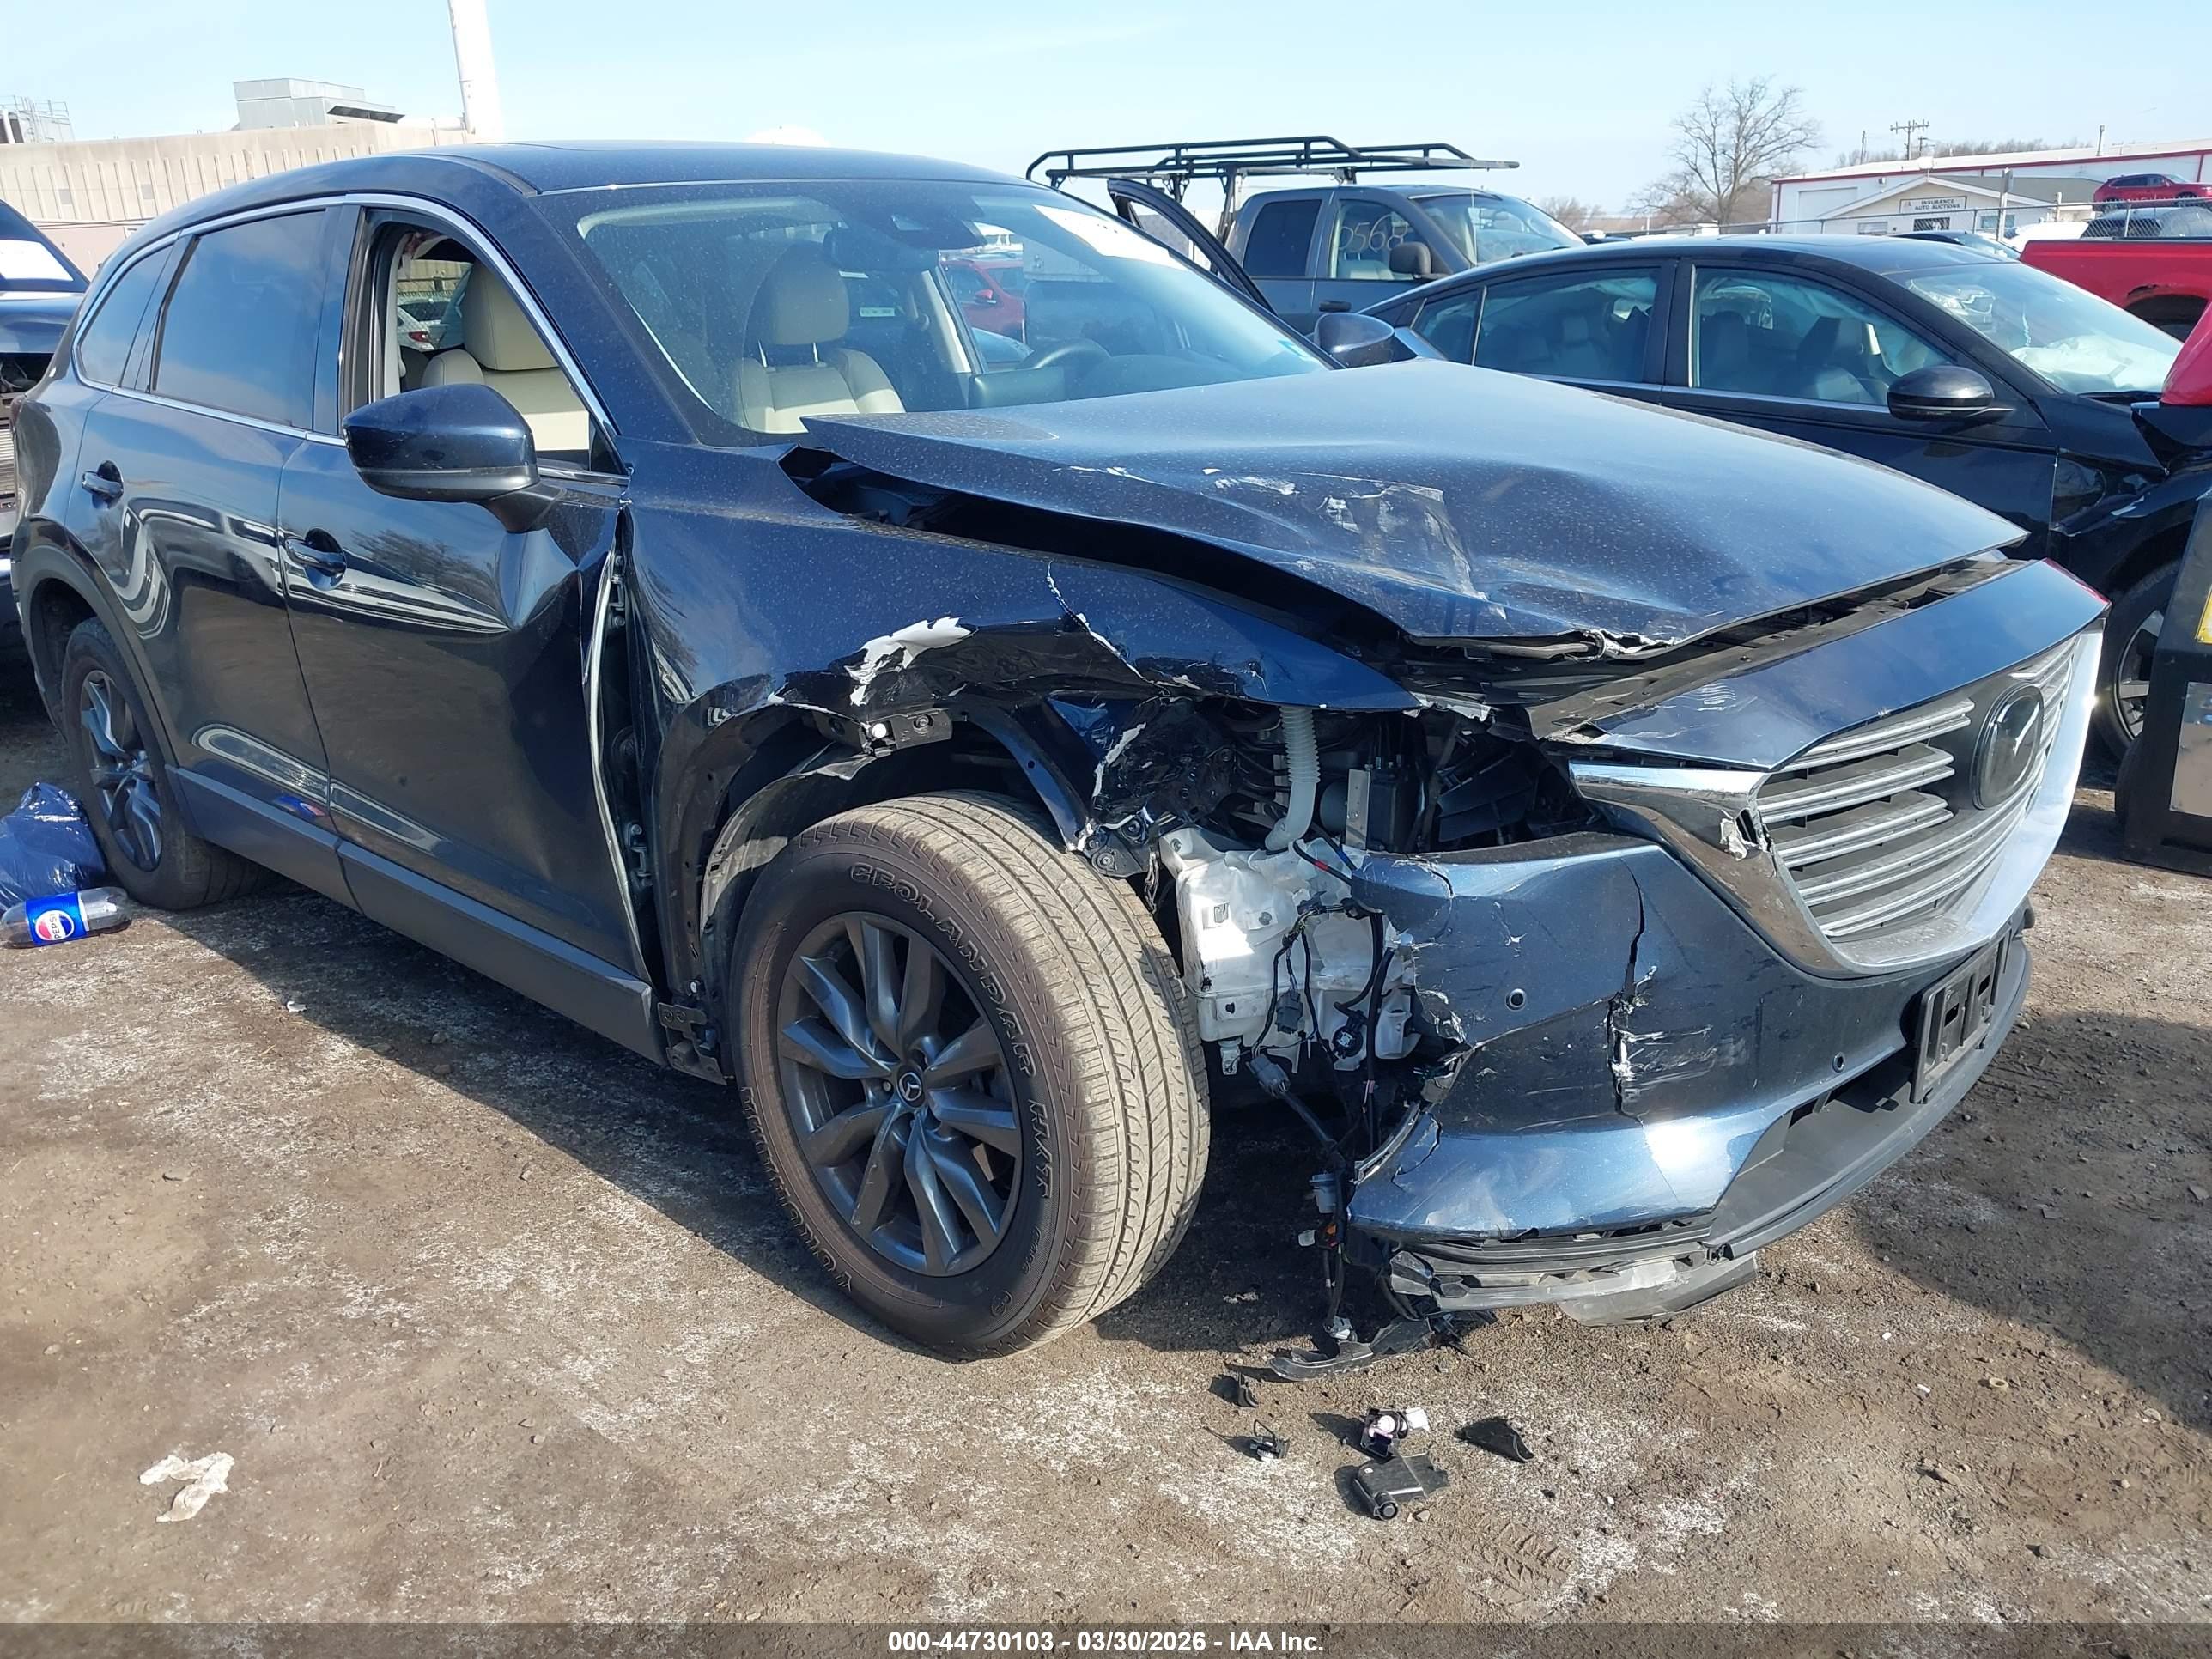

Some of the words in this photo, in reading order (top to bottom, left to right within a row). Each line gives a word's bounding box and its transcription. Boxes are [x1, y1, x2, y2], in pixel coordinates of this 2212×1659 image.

[49, 913, 61, 939] PEPSI
[849, 861, 1036, 1078] GEOLANDAR
[740, 1086, 853, 1292] YOKOHAMA
